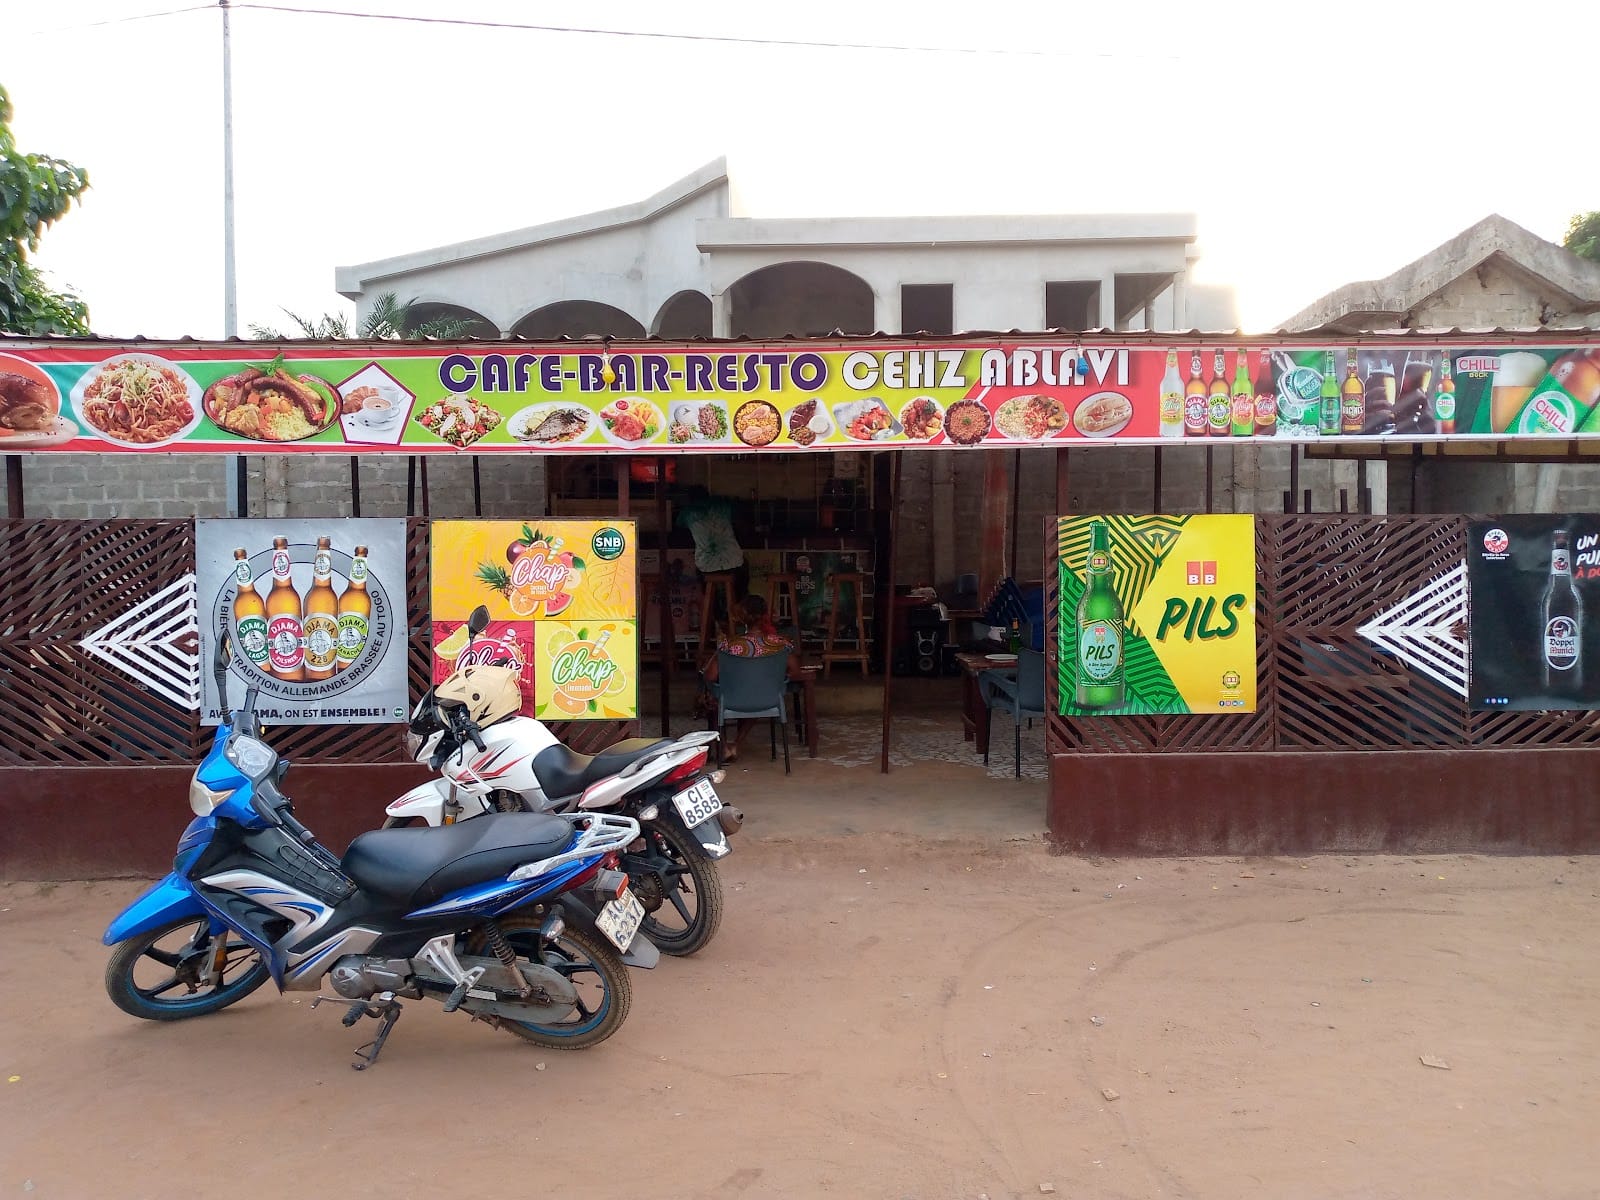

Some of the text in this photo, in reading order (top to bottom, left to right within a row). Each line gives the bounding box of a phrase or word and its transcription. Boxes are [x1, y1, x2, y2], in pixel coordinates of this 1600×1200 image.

[439, 349, 1129, 393] CAFE-BAR-RESTO CEHZ ABLAVI
[1458, 359, 1501, 371] CHILL
[1535, 399, 1567, 432] CHILL
[596, 536, 621, 547] SNB
[1576, 534, 1599, 550] UN
[1576, 550, 1600, 566] PUI
[511, 554, 570, 591] Chap
[339, 619, 364, 630] DJAMA
[1156, 594, 1247, 642] PILS
[240, 622, 265, 634] DJAMA
[271, 622, 299, 633] DJAMA
[306, 621, 335, 635] DJAMA
[219, 588, 386, 696] LA BIÈR TRADITION ALLEMANDE BRASSÉE AU TOGO
[311, 655, 328, 663] 228
[1085, 644, 1115, 661] PILS
[552, 648, 617, 689] Chap
[284, 710, 299, 718] ON
[303, 710, 318, 718] EST
[320, 708, 381, 718] ENSEMBLE
[687, 787, 703, 803] CI
[685, 794, 720, 824] 8585
